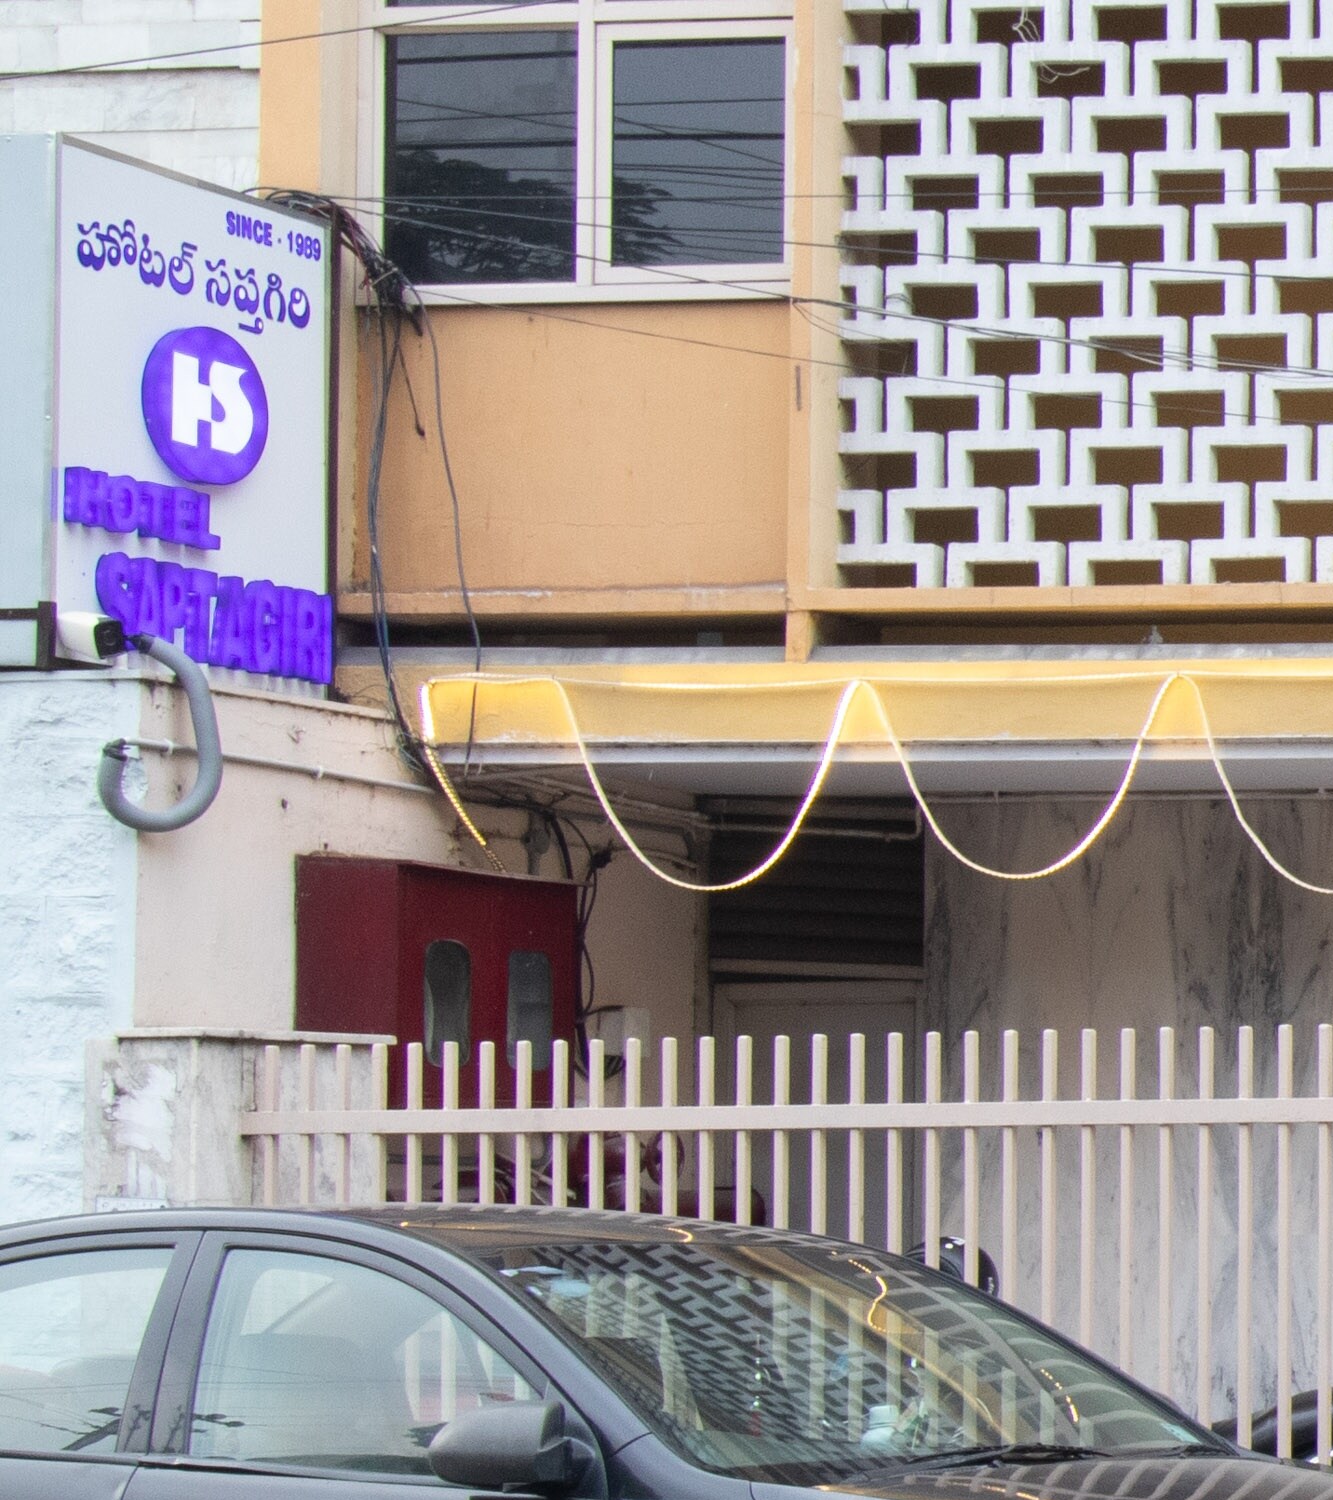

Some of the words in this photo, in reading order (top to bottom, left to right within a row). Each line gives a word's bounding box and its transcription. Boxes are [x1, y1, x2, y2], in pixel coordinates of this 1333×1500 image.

[76, 219, 198, 295] హోటల్
[205, 259, 310, 335] సప్తగిరి
[226, 211, 273, 247] SINCE
[287, 231, 322, 262] 1989
[171, 350, 254, 455] HS
[64, 466, 221, 550] HOTEL
[96, 552, 333, 684] SAPTAGIRI
